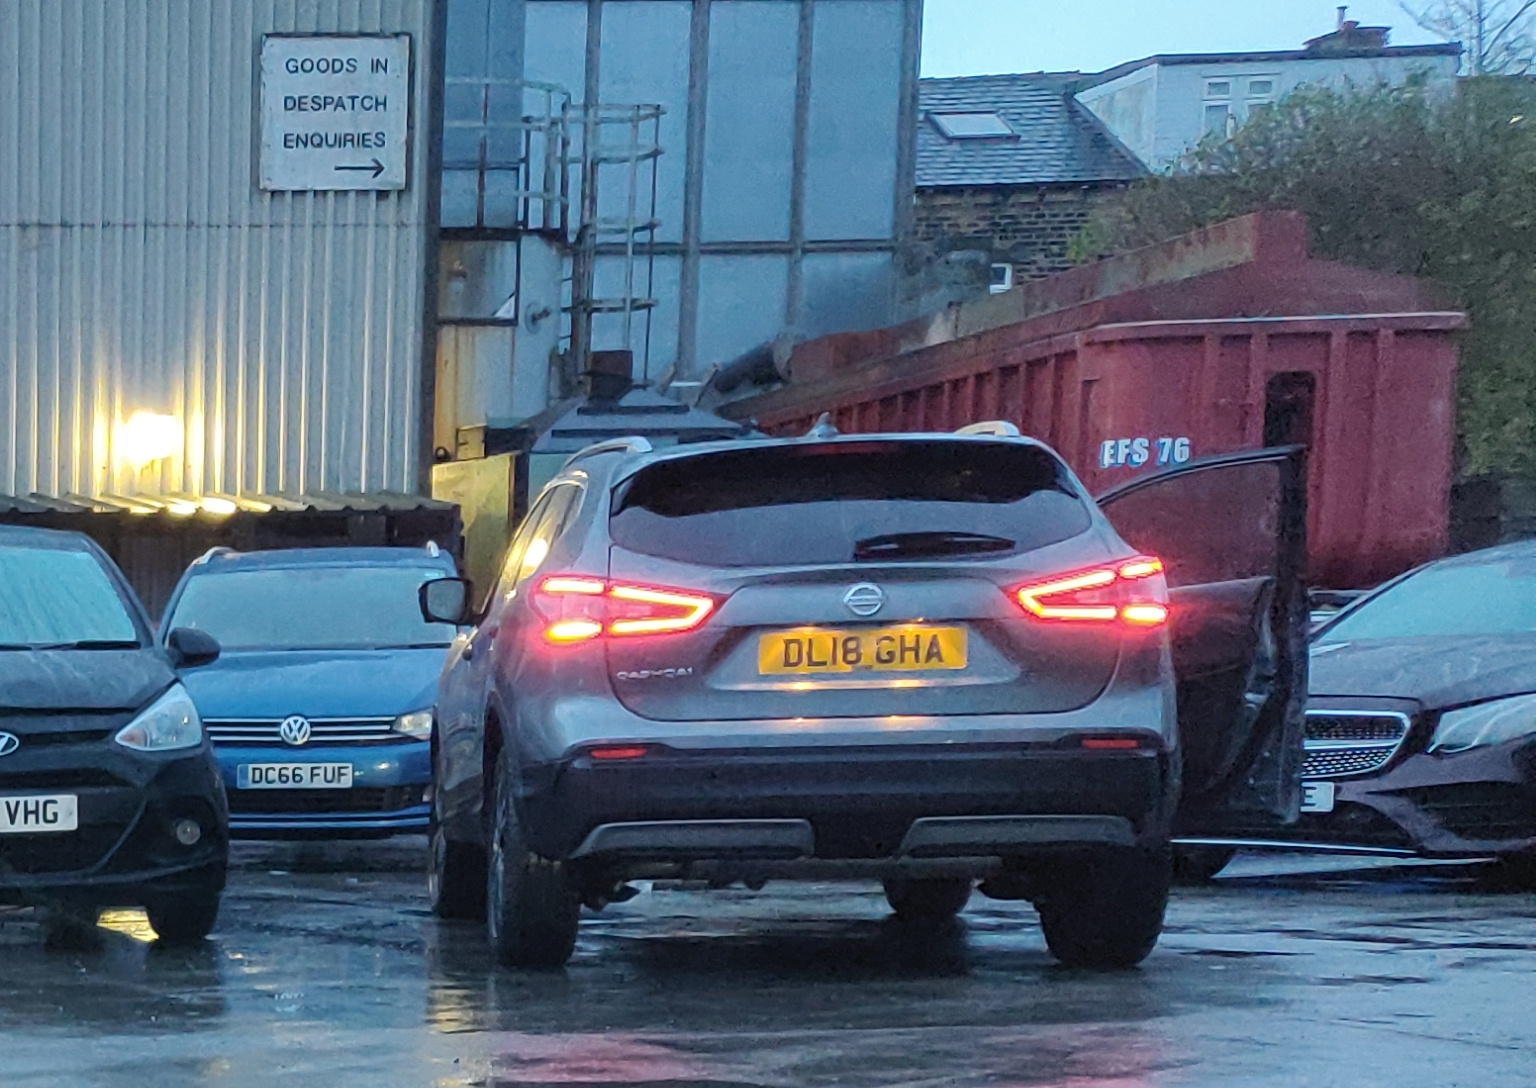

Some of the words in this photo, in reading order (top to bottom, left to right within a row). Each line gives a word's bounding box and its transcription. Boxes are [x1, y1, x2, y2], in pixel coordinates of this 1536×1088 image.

[284, 57, 358, 74] GOODS
[370, 57, 388, 74] IN
[283, 95, 388, 112] DESPATCH
[283, 131, 386, 149] ENQUIRIES
[1099, 437, 1150, 469] EFS
[1155, 436, 1191, 466] 76
[782, 636, 863, 668] DL18
[875, 633, 945, 665] GHA
[251, 766, 304, 785] DC66
[310, 765, 350, 784] FUF
[4, 798, 59, 826] VHG
